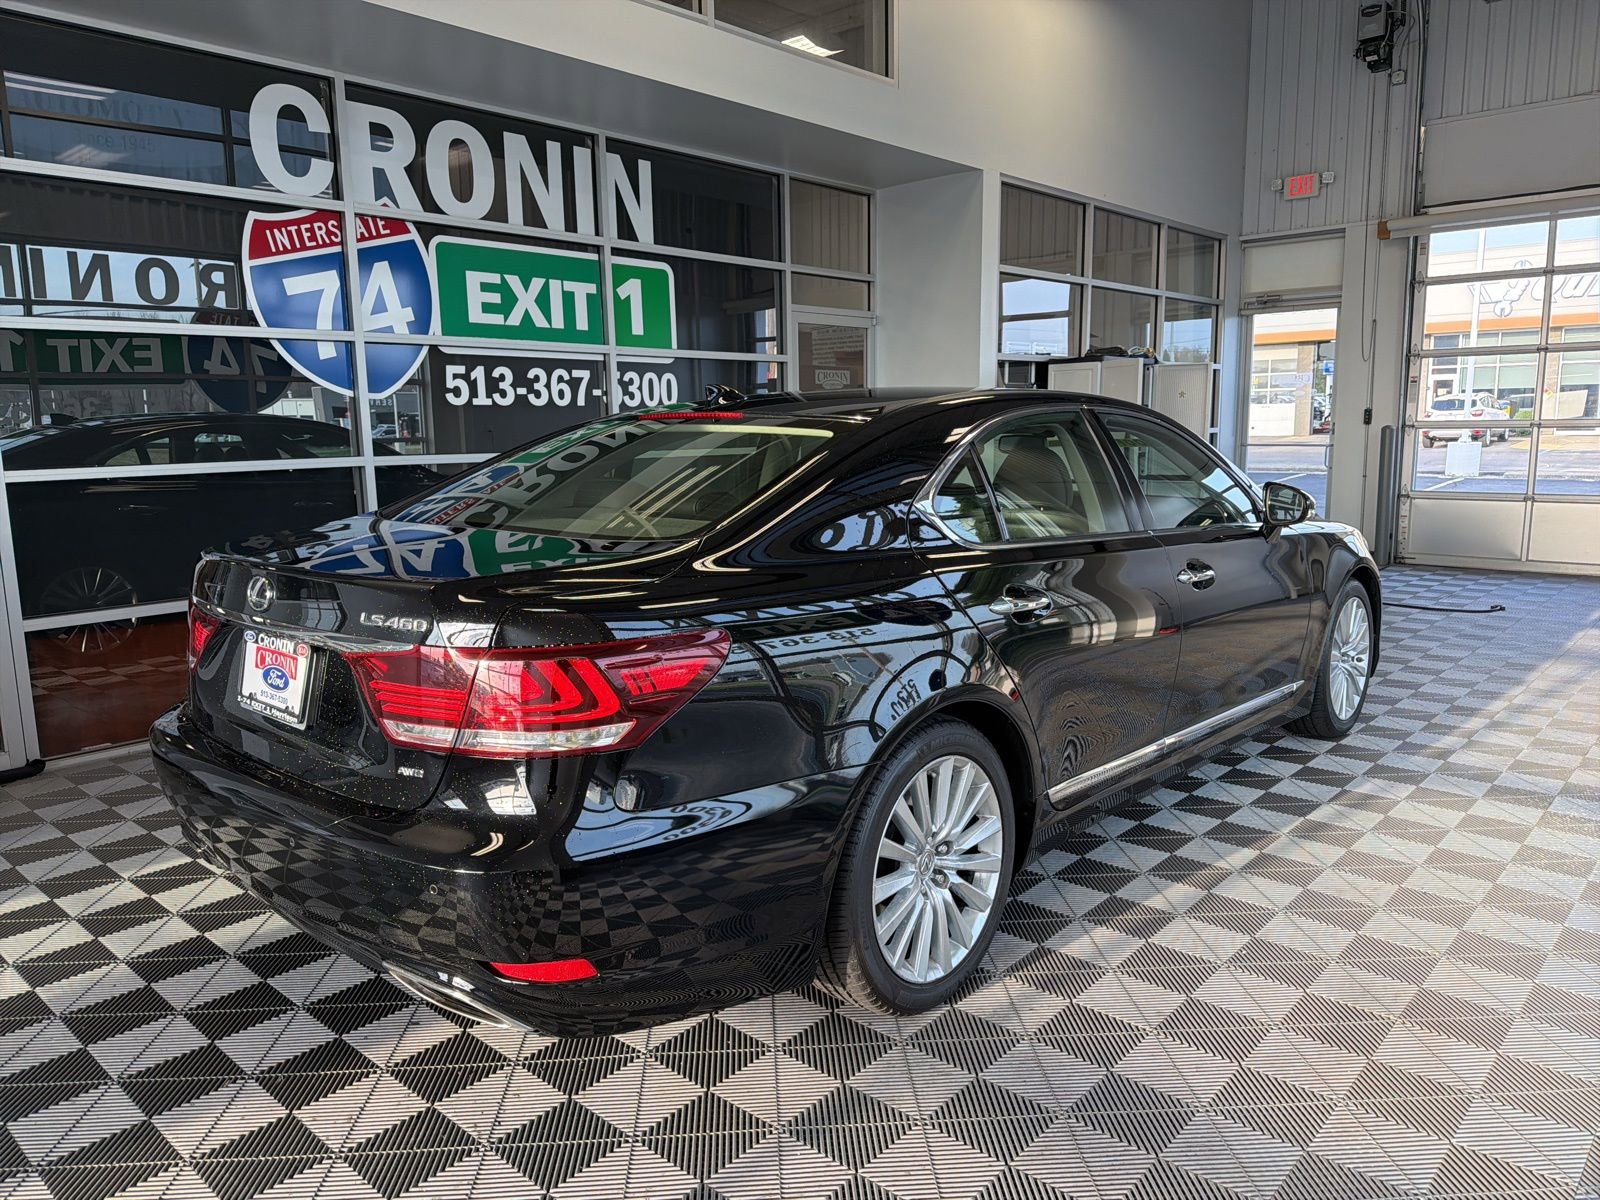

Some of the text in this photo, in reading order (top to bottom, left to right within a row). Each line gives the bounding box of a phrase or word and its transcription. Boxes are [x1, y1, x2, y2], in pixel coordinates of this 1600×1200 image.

[249, 83, 654, 244] CRONIN
[1289, 175, 1314, 196] EXIT
[265, 216, 391, 253] INTERSATE
[283, 261, 415, 361] 74
[465, 270, 644, 336] EXIT 1
[258, 633, 295, 655] CRONIN
[257, 649, 298, 680] CRONIN
[267, 668, 286, 688] Ford
